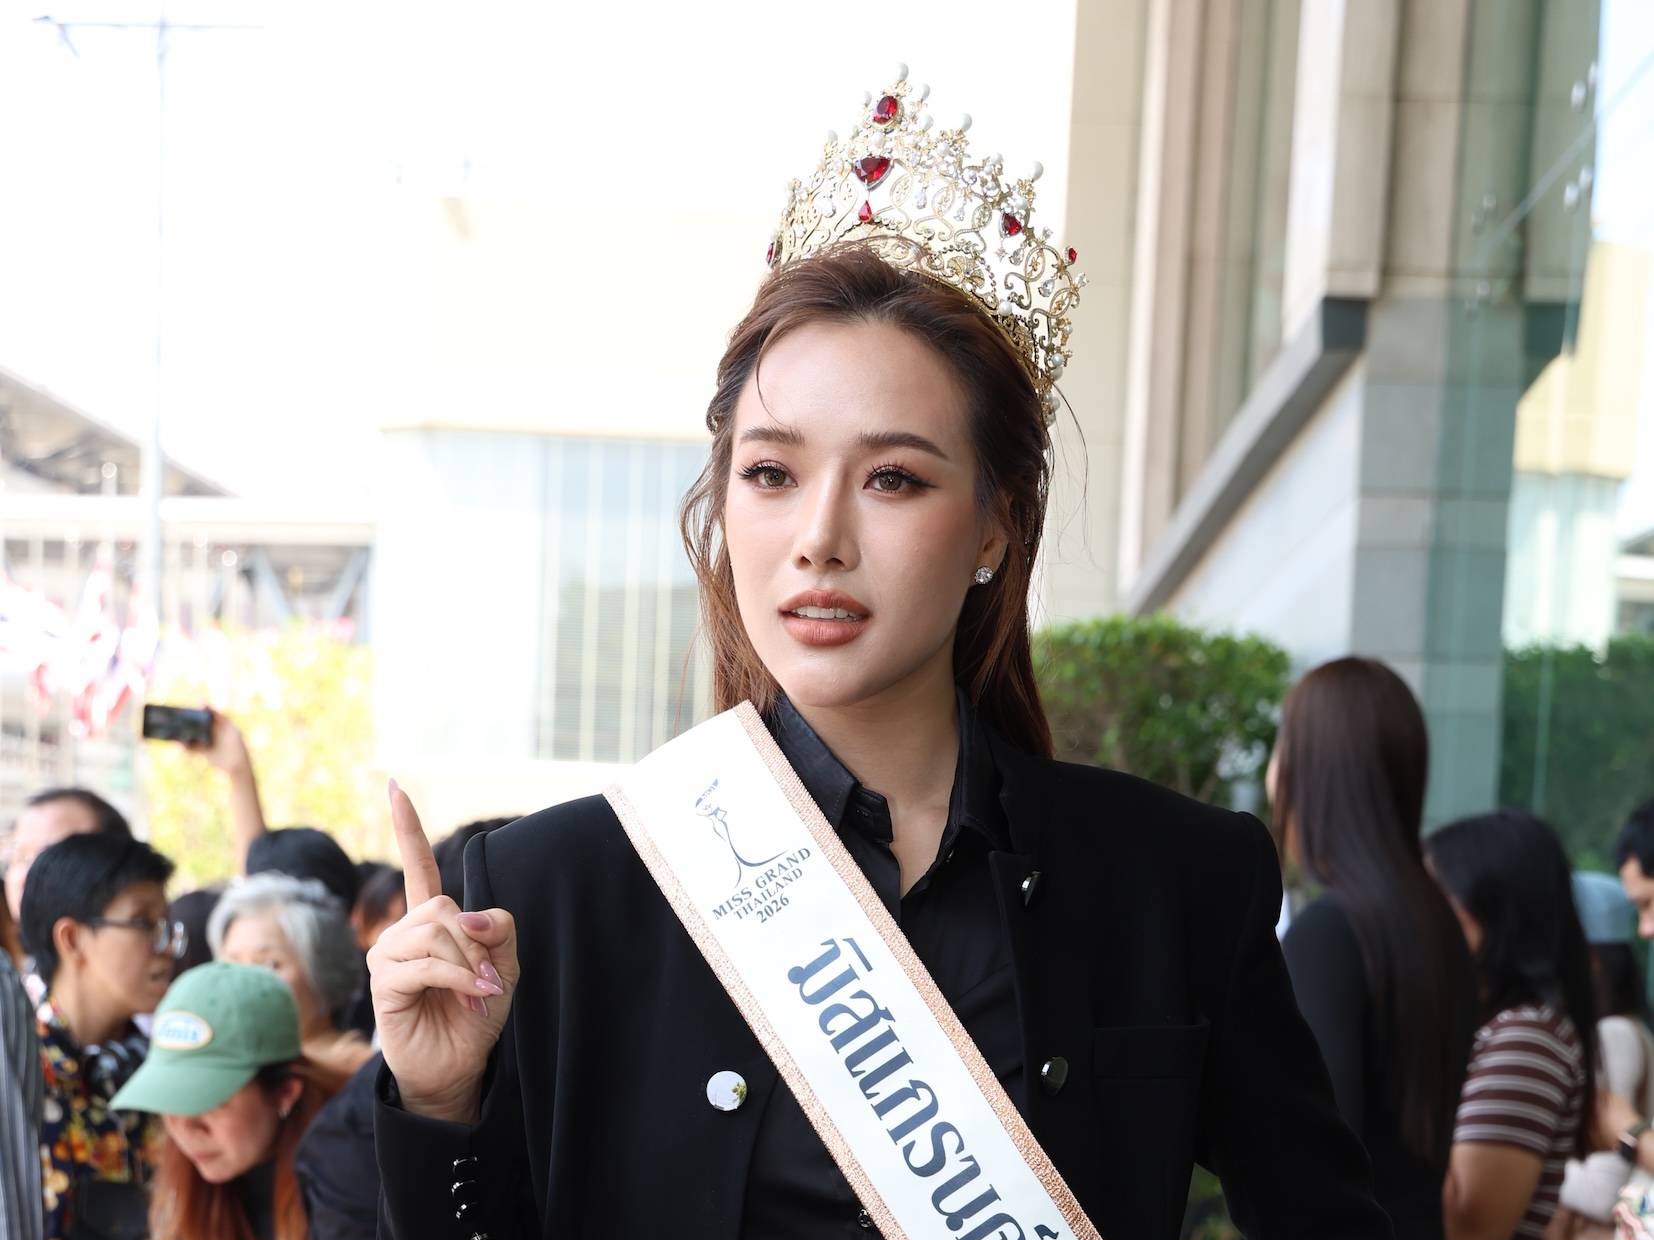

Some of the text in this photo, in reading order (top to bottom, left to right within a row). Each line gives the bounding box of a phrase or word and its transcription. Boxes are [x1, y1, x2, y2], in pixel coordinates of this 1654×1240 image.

[712, 847, 811, 920] MISS GRAND
[733, 867, 803, 920] THAILAND
[756, 893, 790, 924] 2026
